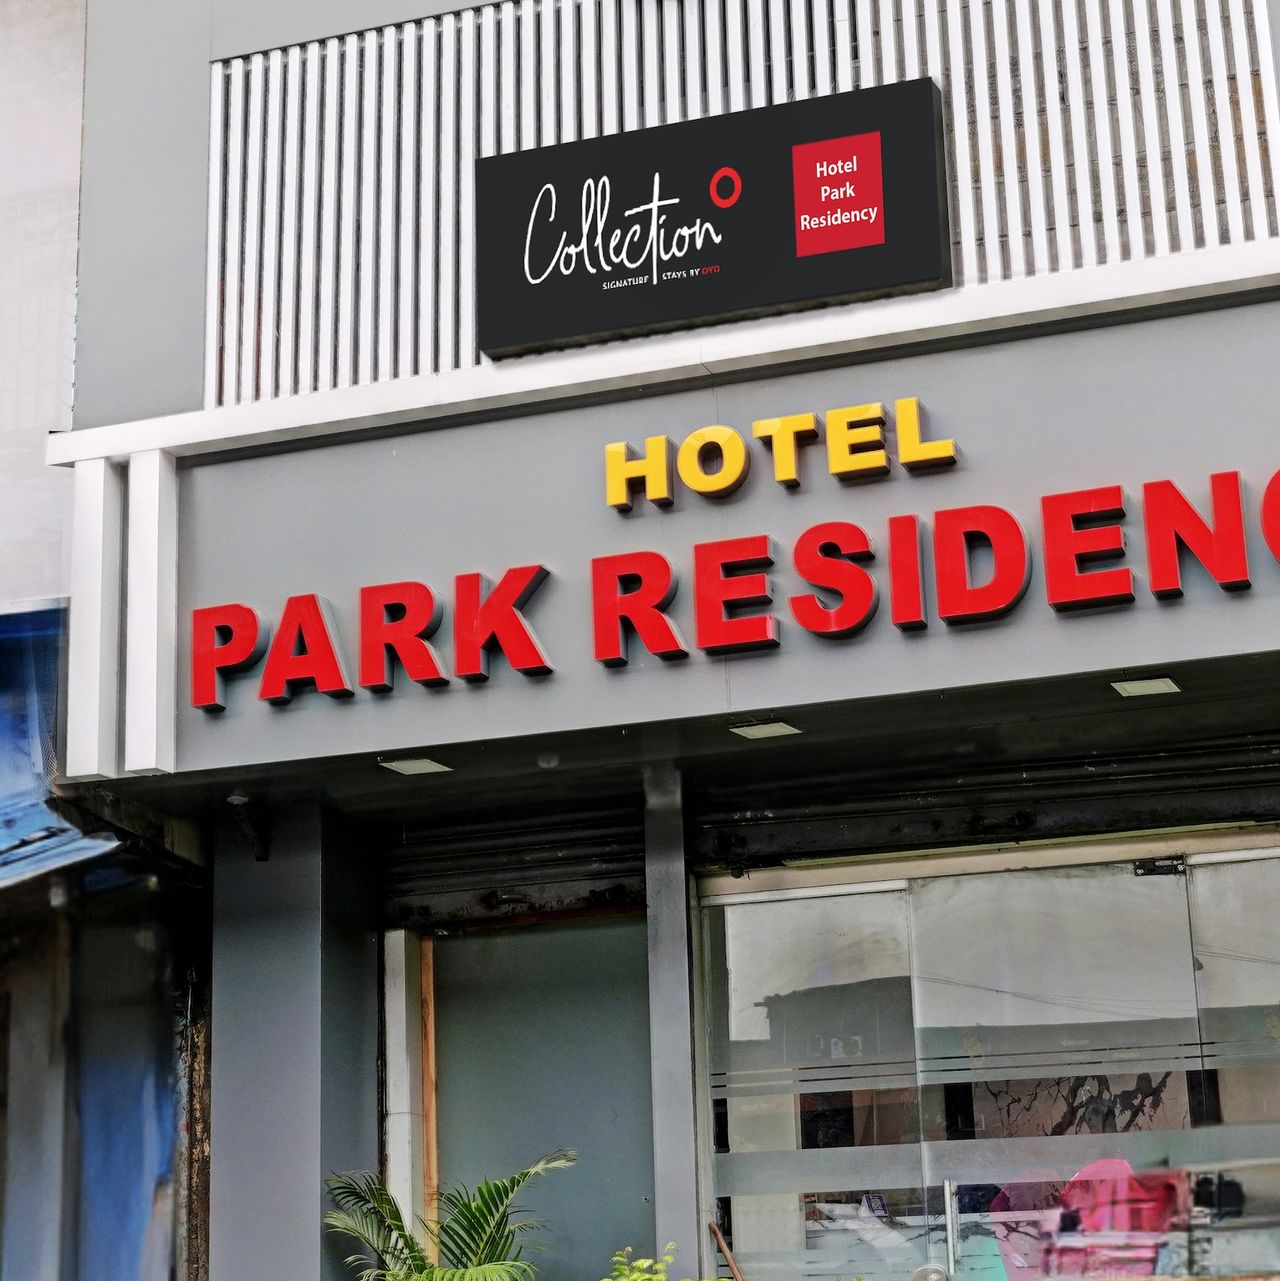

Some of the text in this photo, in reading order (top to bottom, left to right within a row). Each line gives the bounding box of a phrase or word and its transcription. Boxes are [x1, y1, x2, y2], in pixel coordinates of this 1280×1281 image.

[816, 155, 858, 178] Hotel
[820, 181, 856, 202] Park
[524, 172, 723, 286] Collection
[800, 203, 878, 231] Residency
[602, 275, 649, 290] SIGNATURE
[662, 270, 687, 280] STAYS
[701, 265, 720, 275] OYO
[605, 398, 959, 509] HOTEL
[191, 564, 552, 710] PARK
